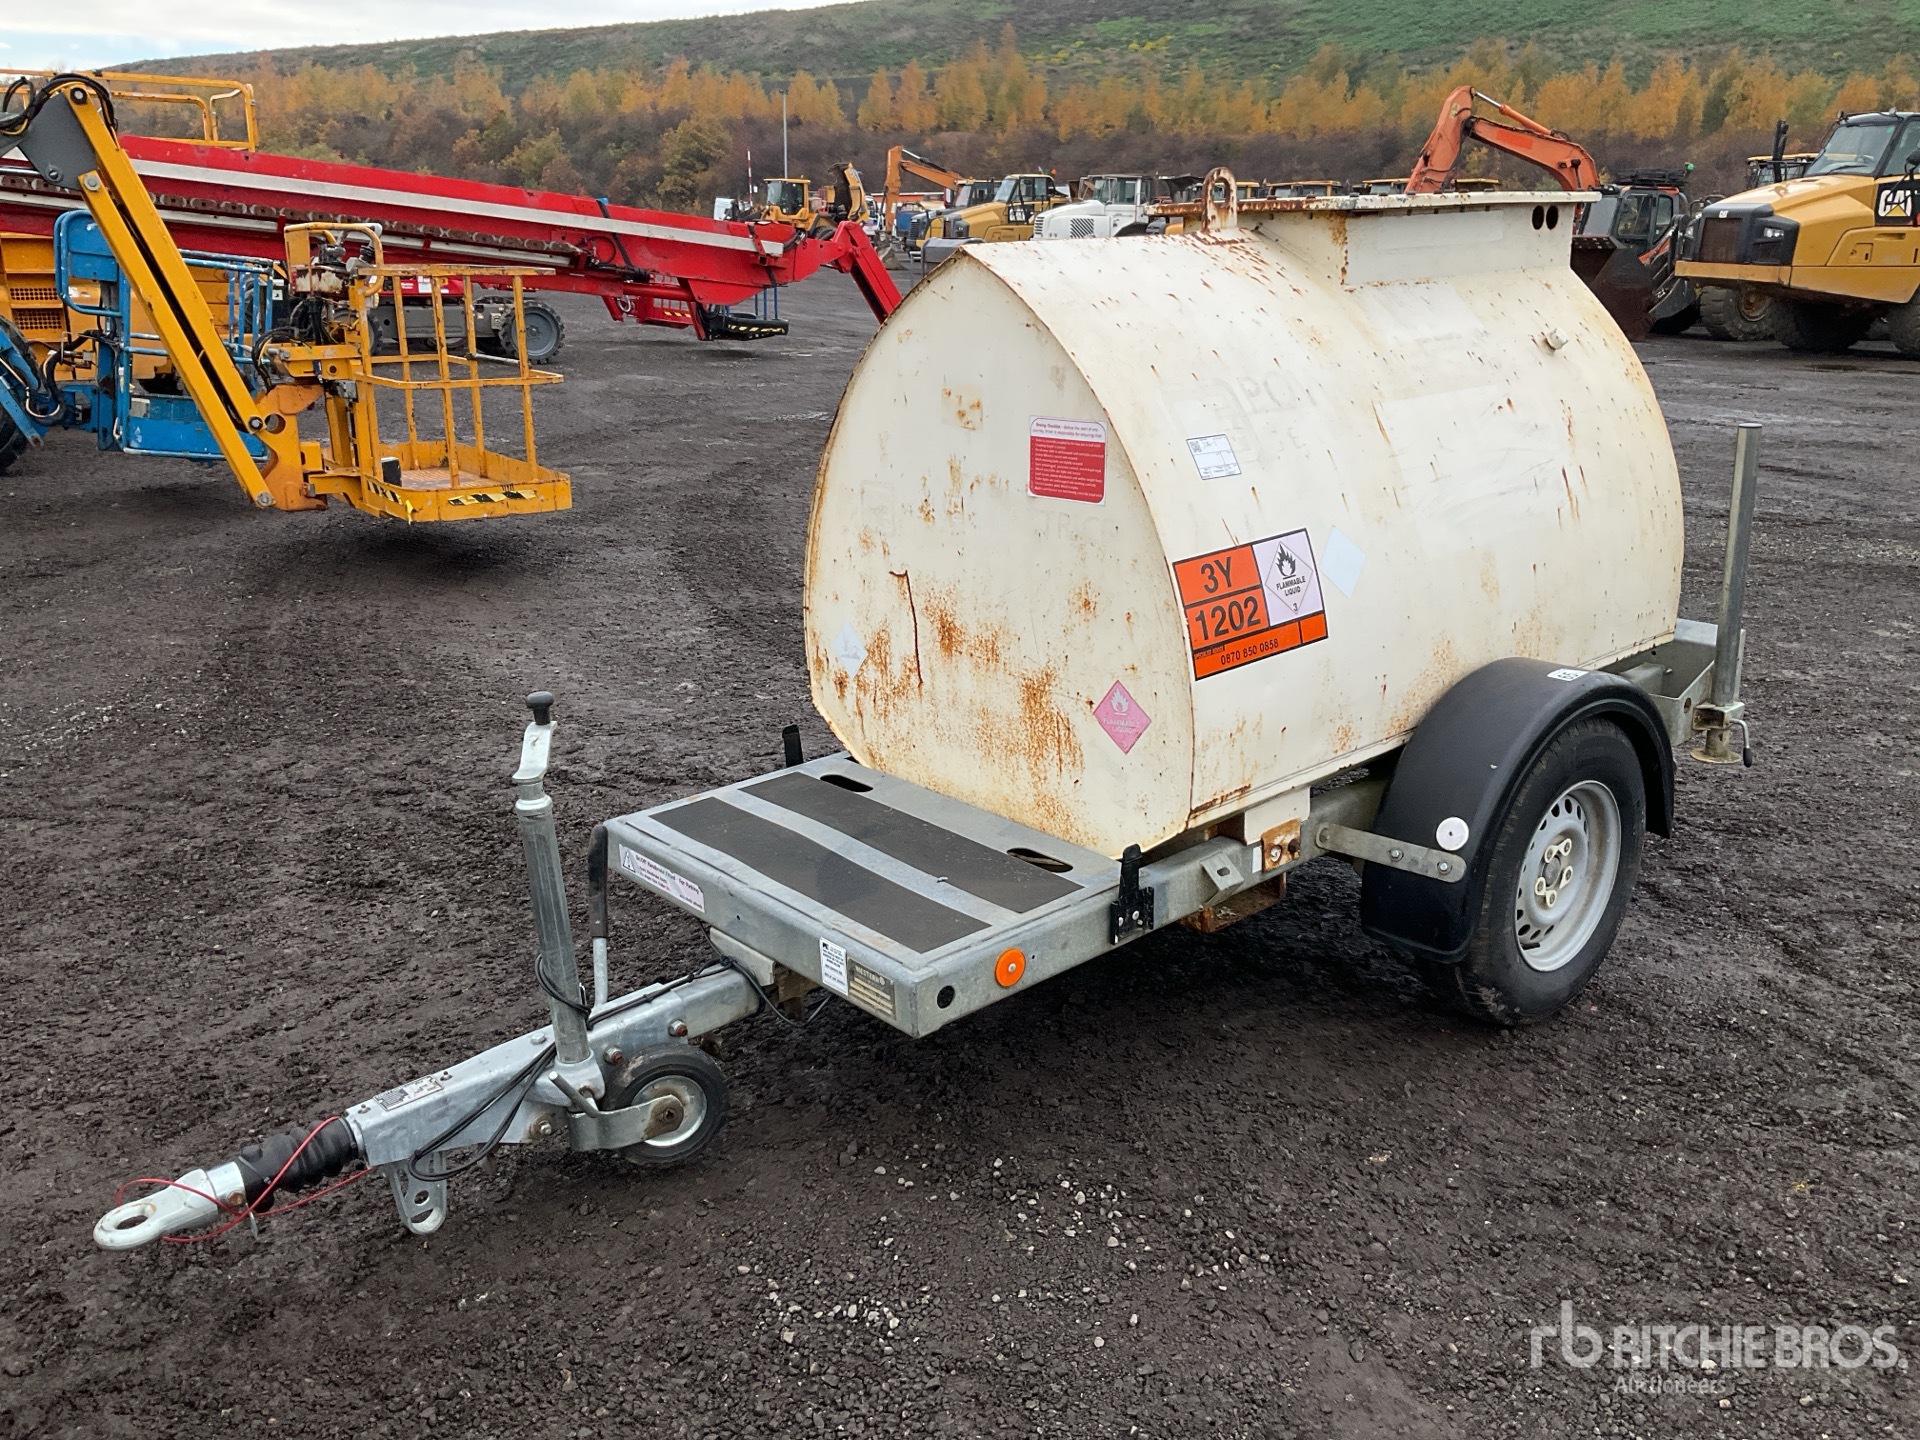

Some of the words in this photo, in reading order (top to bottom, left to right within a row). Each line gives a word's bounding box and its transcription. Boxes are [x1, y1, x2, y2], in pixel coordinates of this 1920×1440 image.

[1878, 189, 1912, 217] CAT
[1201, 556, 1232, 593] 3Y
[1276, 575, 1306, 590] FLAMMABLE
[1285, 585, 1301, 597] LIQUID
[1195, 595, 1261, 641] 1202
[1293, 602, 1298, 612] 3
[1220, 650, 1241, 665] 0870
[1243, 645, 1257, 658] 850
[1260, 638, 1279, 652] 0858
